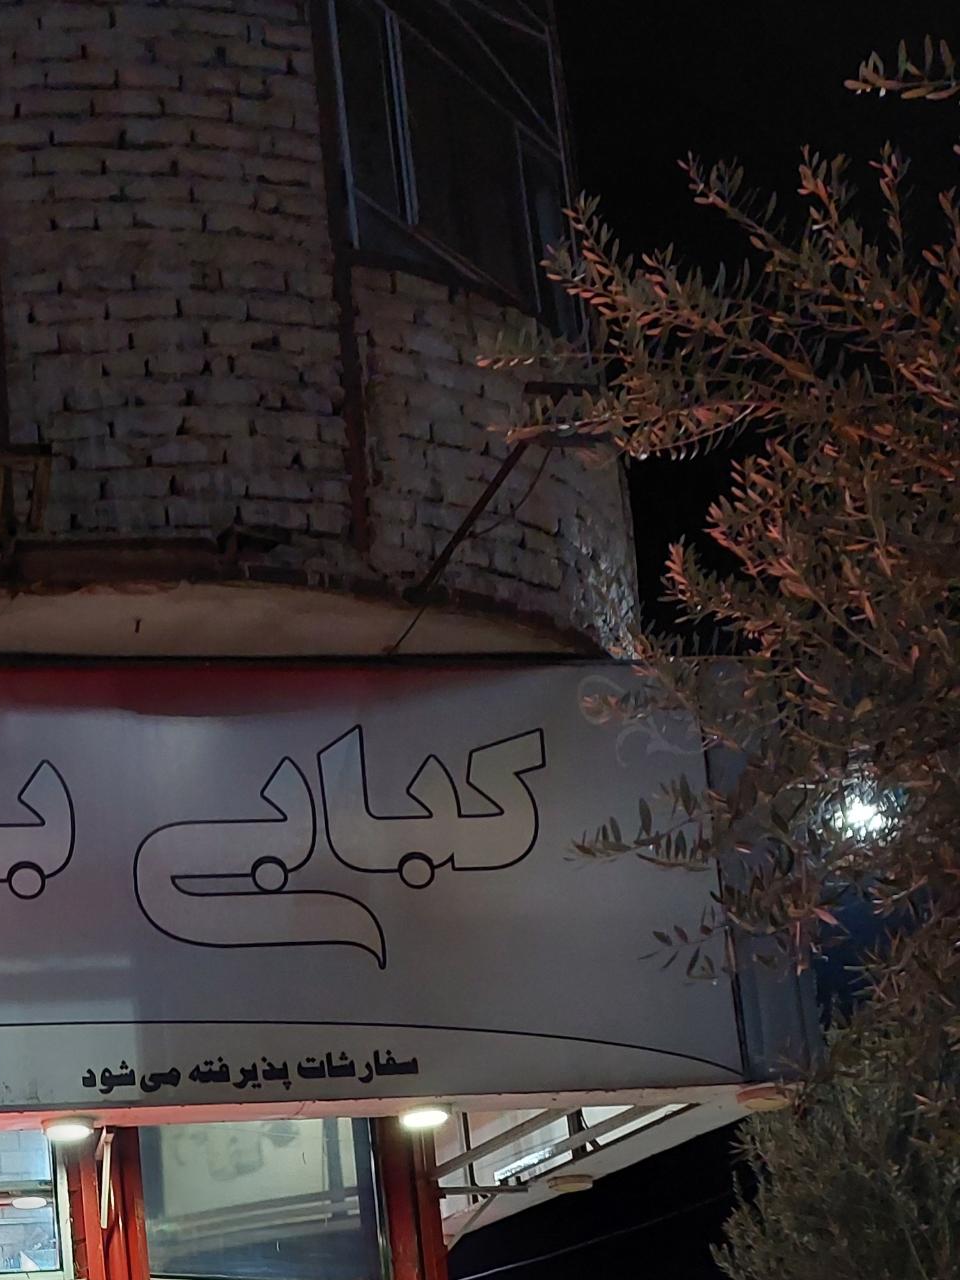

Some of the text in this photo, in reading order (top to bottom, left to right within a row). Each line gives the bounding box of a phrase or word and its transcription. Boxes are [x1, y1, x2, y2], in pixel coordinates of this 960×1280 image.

[134, 723, 546, 970] کبابی
[189, 1056, 292, 1091] پذیرفته
[297, 1050, 420, 1084] سفارشات
